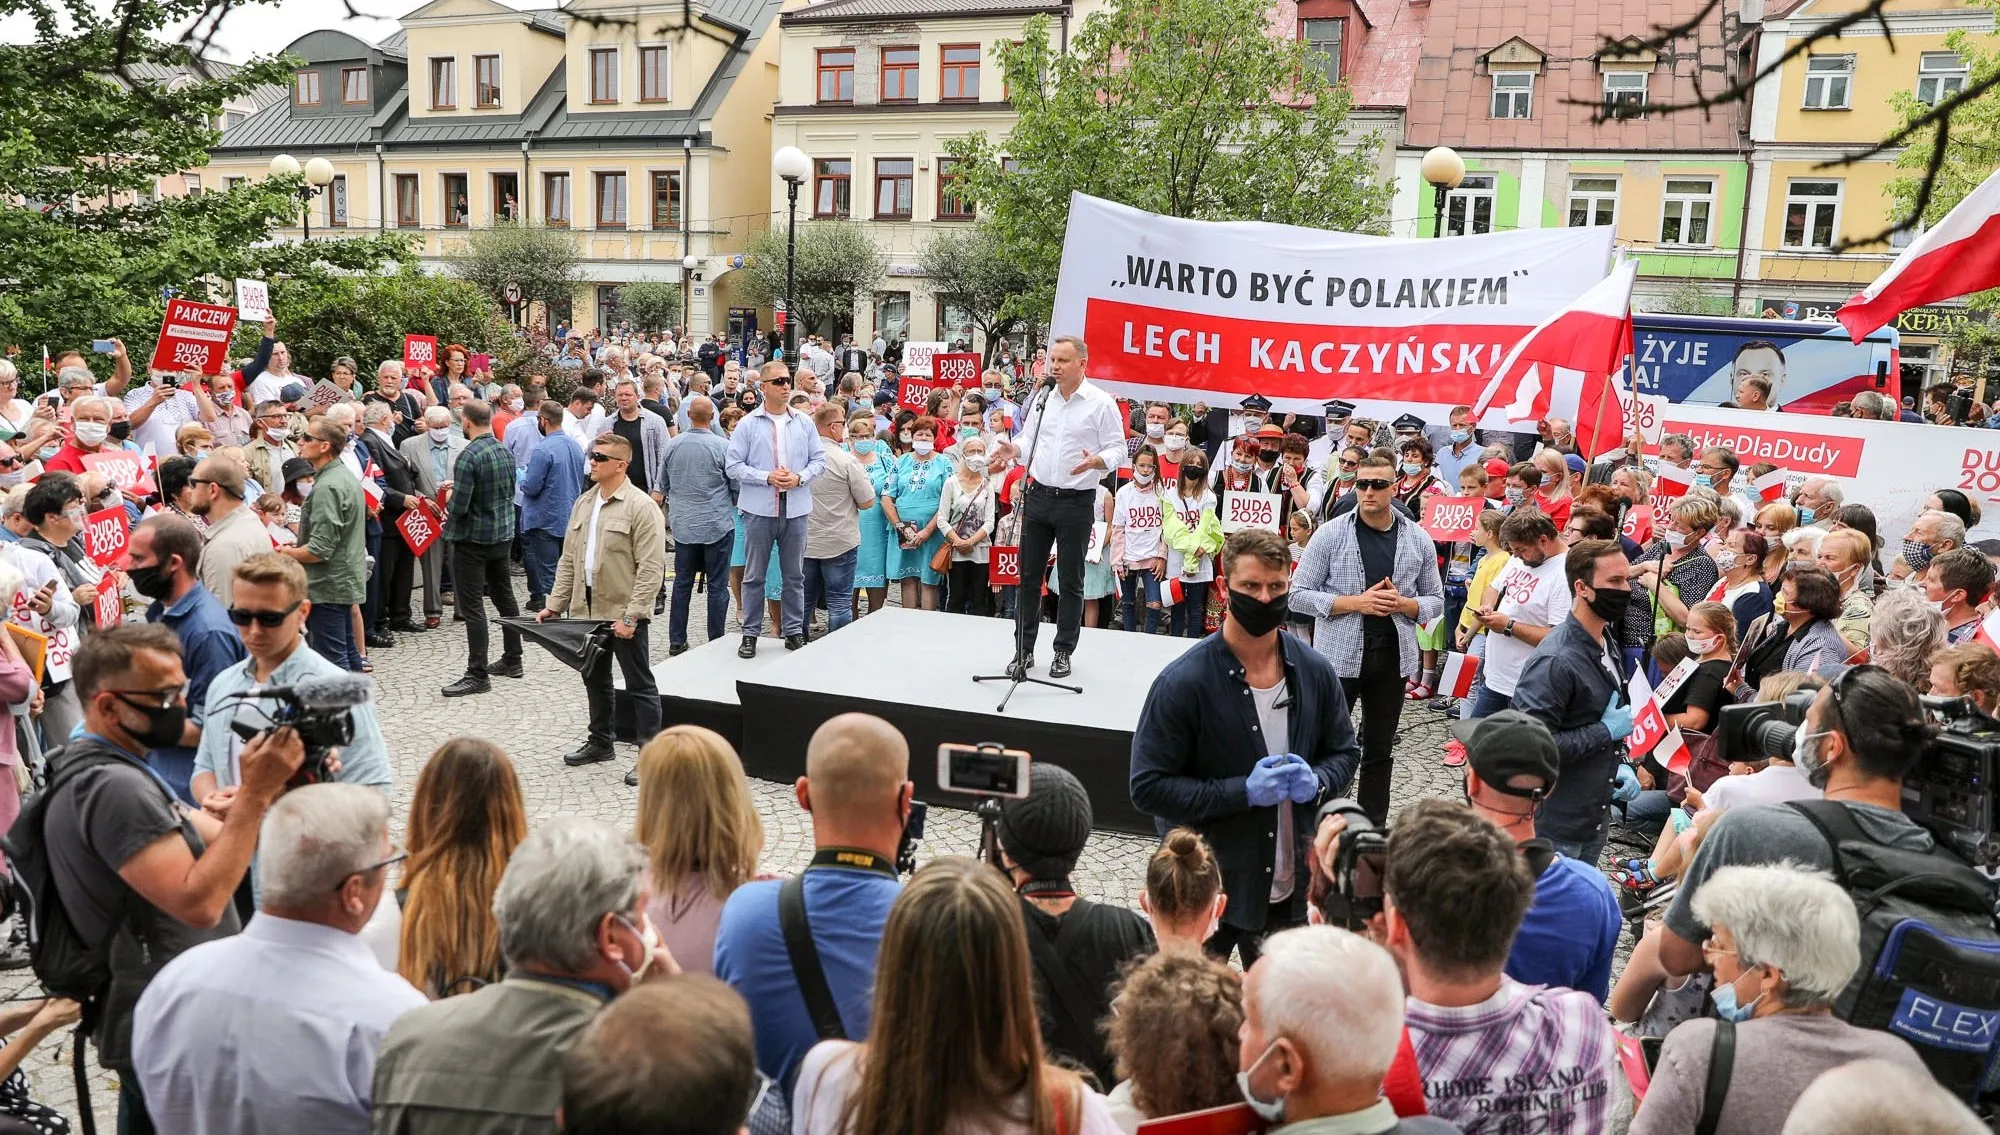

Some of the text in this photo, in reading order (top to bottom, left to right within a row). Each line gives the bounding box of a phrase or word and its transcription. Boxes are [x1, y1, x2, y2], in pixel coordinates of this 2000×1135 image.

[243, 285, 265, 299] DUDA
[1250, 270, 1314, 306] BYĆ
[243, 297, 266, 310] 2020
[174, 305, 231, 326] PARCZEW
[175, 342, 210, 356] DUDA
[410, 341, 432, 352] DUDA
[1122, 321, 1221, 365] LECH
[1641, 334, 1709, 366] ŻYJE
[173, 353, 208, 366] 2020
[409, 350, 433, 361] 2020
[940, 358, 975, 370] DUDA
[939, 368, 976, 380] 2020
[316, 385, 342, 403] DUDA
[1129, 506, 1162, 518] DUDA
[1231, 498, 1272, 513] DUDA
[1435, 504, 1474, 518] DUDA
[1130, 516, 1162, 528] 2020
[1231, 511, 1273, 525] 2020
[1431, 516, 1473, 530] 2020
[90, 516, 122, 542] DUDA
[92, 536, 124, 557] 2020
[1506, 567, 1540, 592] DUDA
[1908, 996, 1997, 1037] FLEX
[1504, 1066, 1585, 1094] ISLAND
[1571, 1079, 1609, 1105] CLUB
